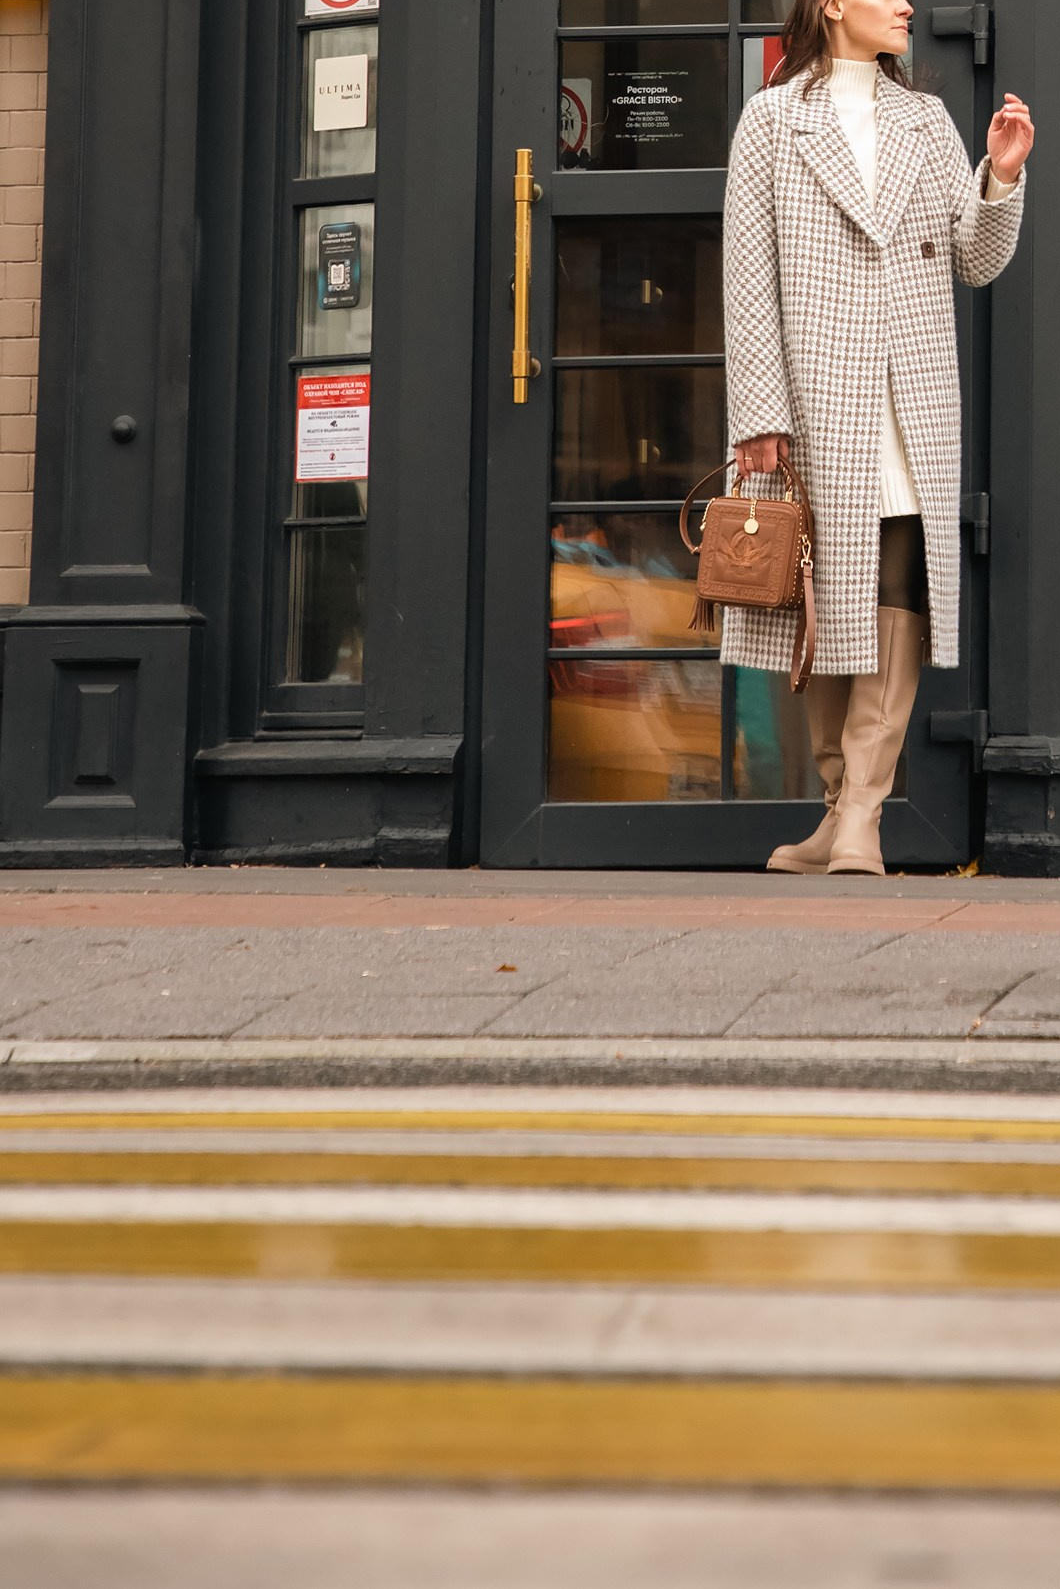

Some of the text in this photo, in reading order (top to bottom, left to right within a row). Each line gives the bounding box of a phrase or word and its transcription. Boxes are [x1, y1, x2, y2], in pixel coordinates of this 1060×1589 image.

[319, 83, 361, 94] ULTIMA
[627, 86, 668, 95] Ресторан
[612, 95, 683, 105] «GRACE BISTRO»
